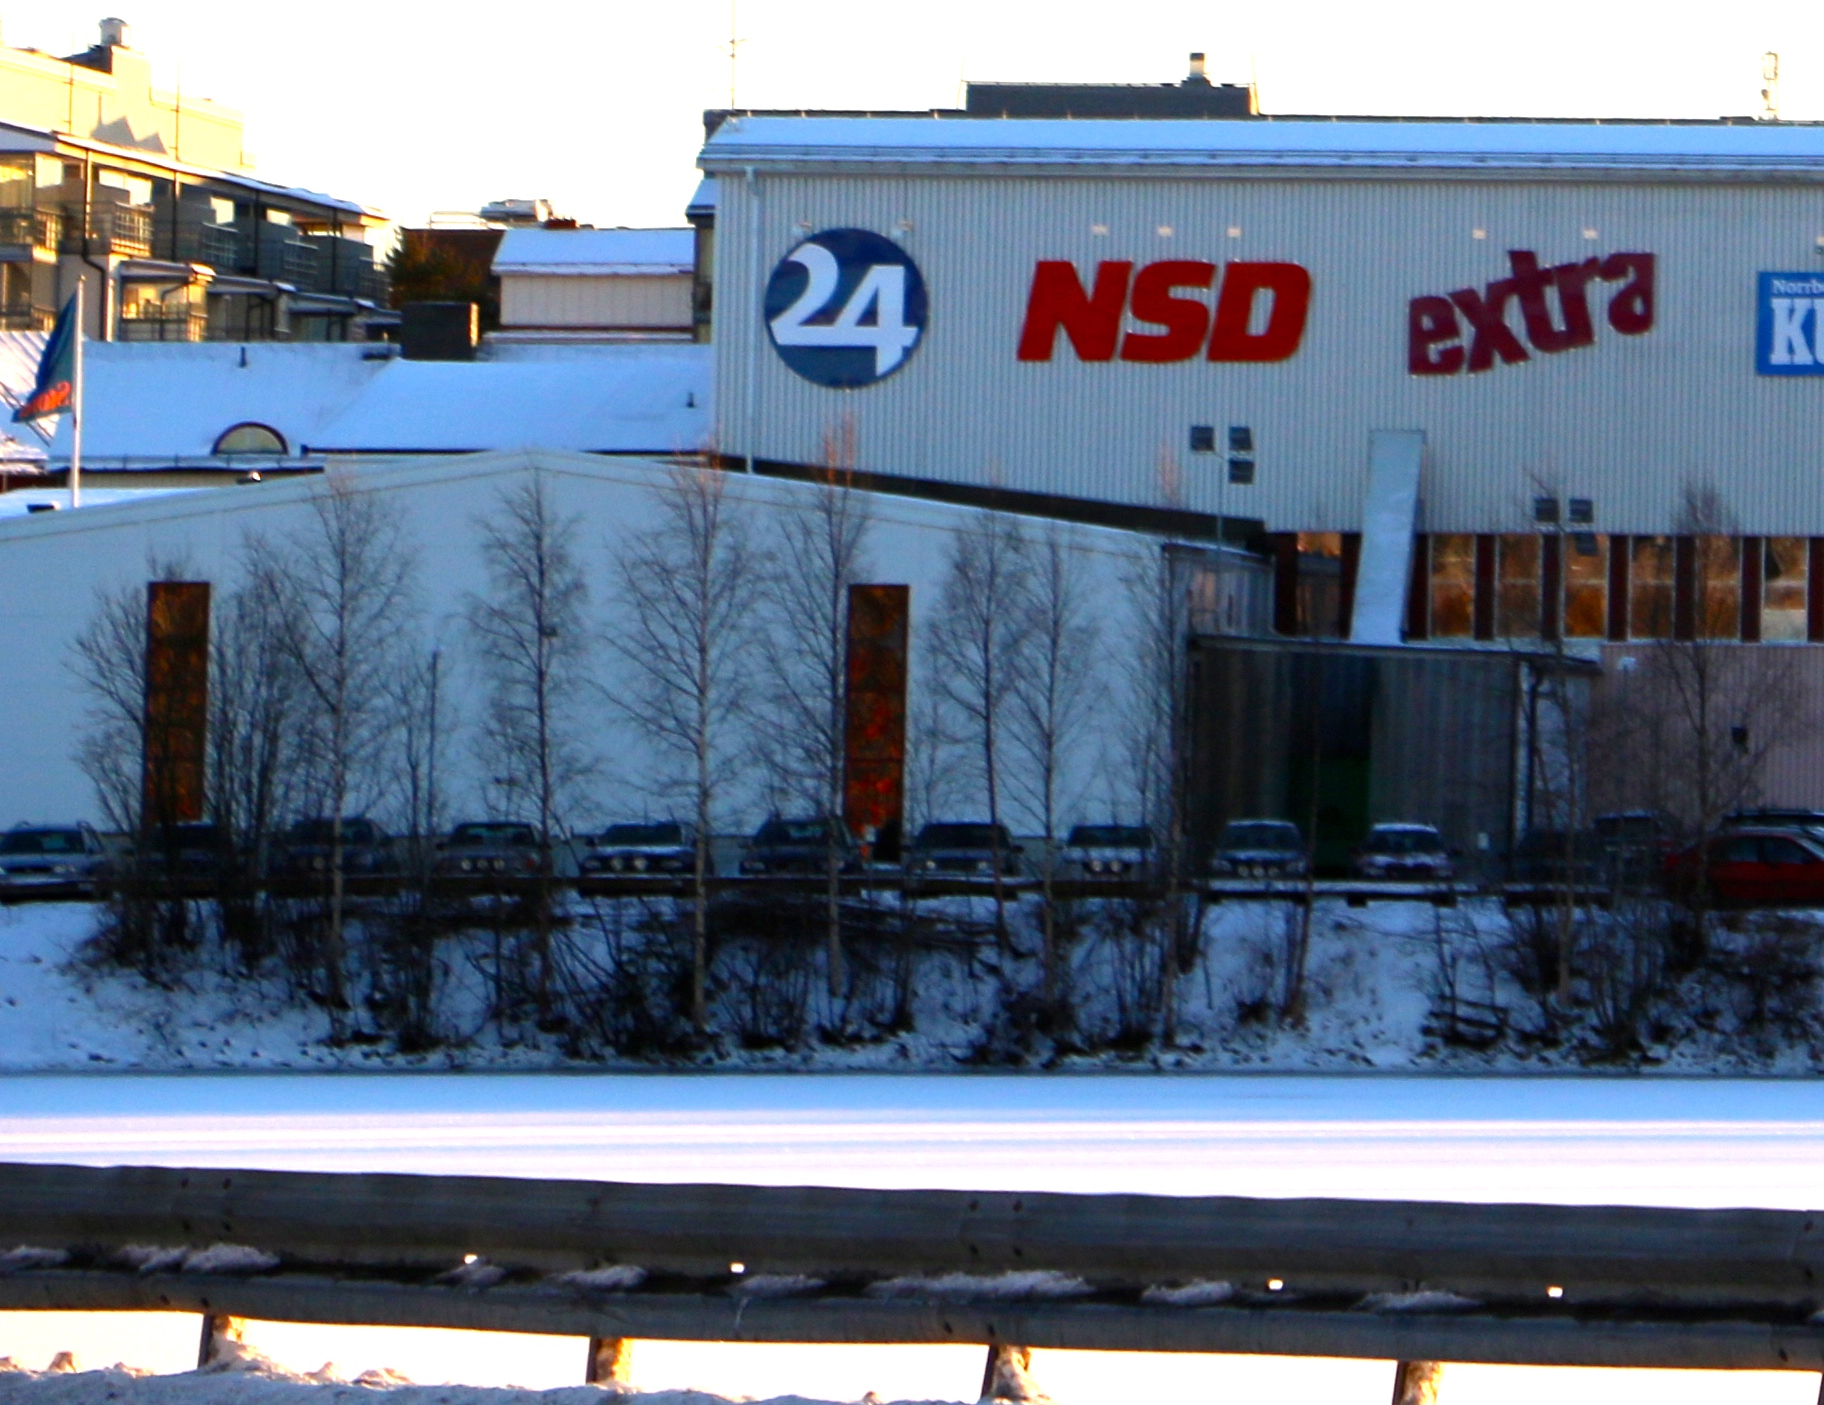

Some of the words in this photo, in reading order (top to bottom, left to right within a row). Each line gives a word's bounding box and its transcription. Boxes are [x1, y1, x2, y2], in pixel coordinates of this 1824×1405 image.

[769, 242, 918, 377] 24
[1016, 259, 1311, 363] NSD
[1407, 250, 1656, 377] extra
